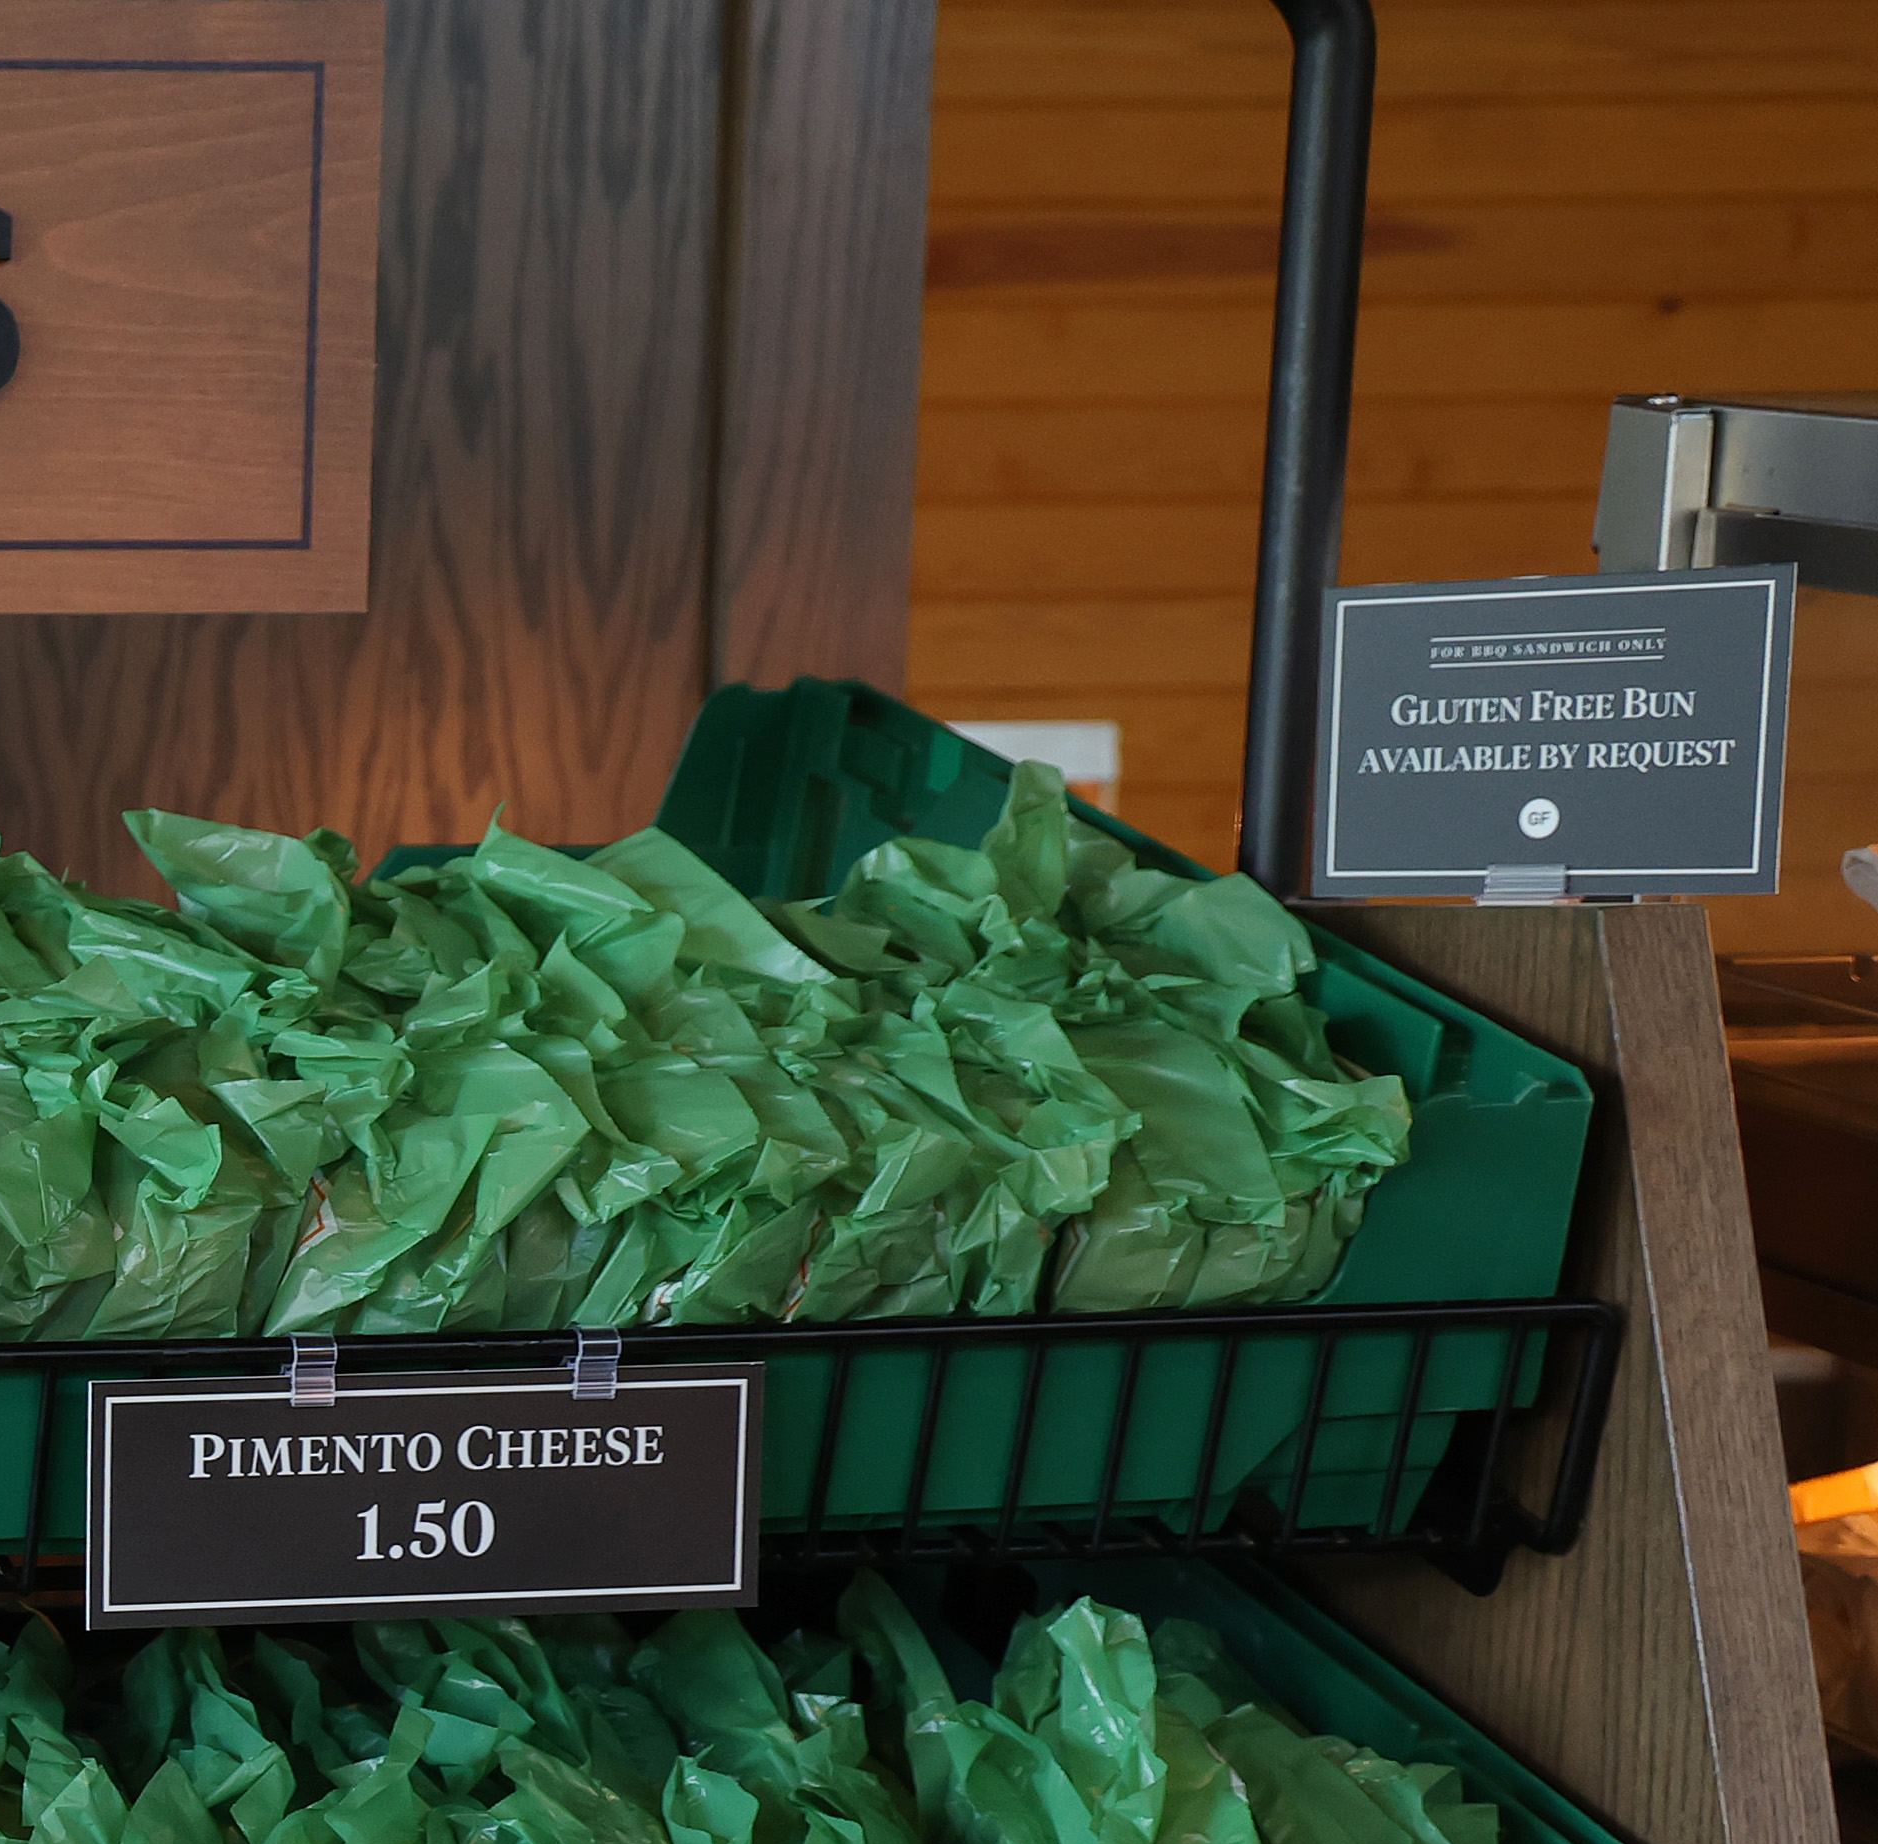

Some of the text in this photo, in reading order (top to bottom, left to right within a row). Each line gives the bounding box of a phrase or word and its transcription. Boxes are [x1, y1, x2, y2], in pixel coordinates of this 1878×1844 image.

[1430, 638, 1664, 659] FOR BBQ SANDWICH ONLY
[1391, 687, 1696, 726] GLUTEN FREE BUN
[1358, 739, 1736, 774] AVAILABLE BY REQUEST
[1527, 811, 1553, 826] GF
[188, 1425, 664, 1479] PIMENTO CHEESE
[356, 1499, 495, 1560] 1.50
